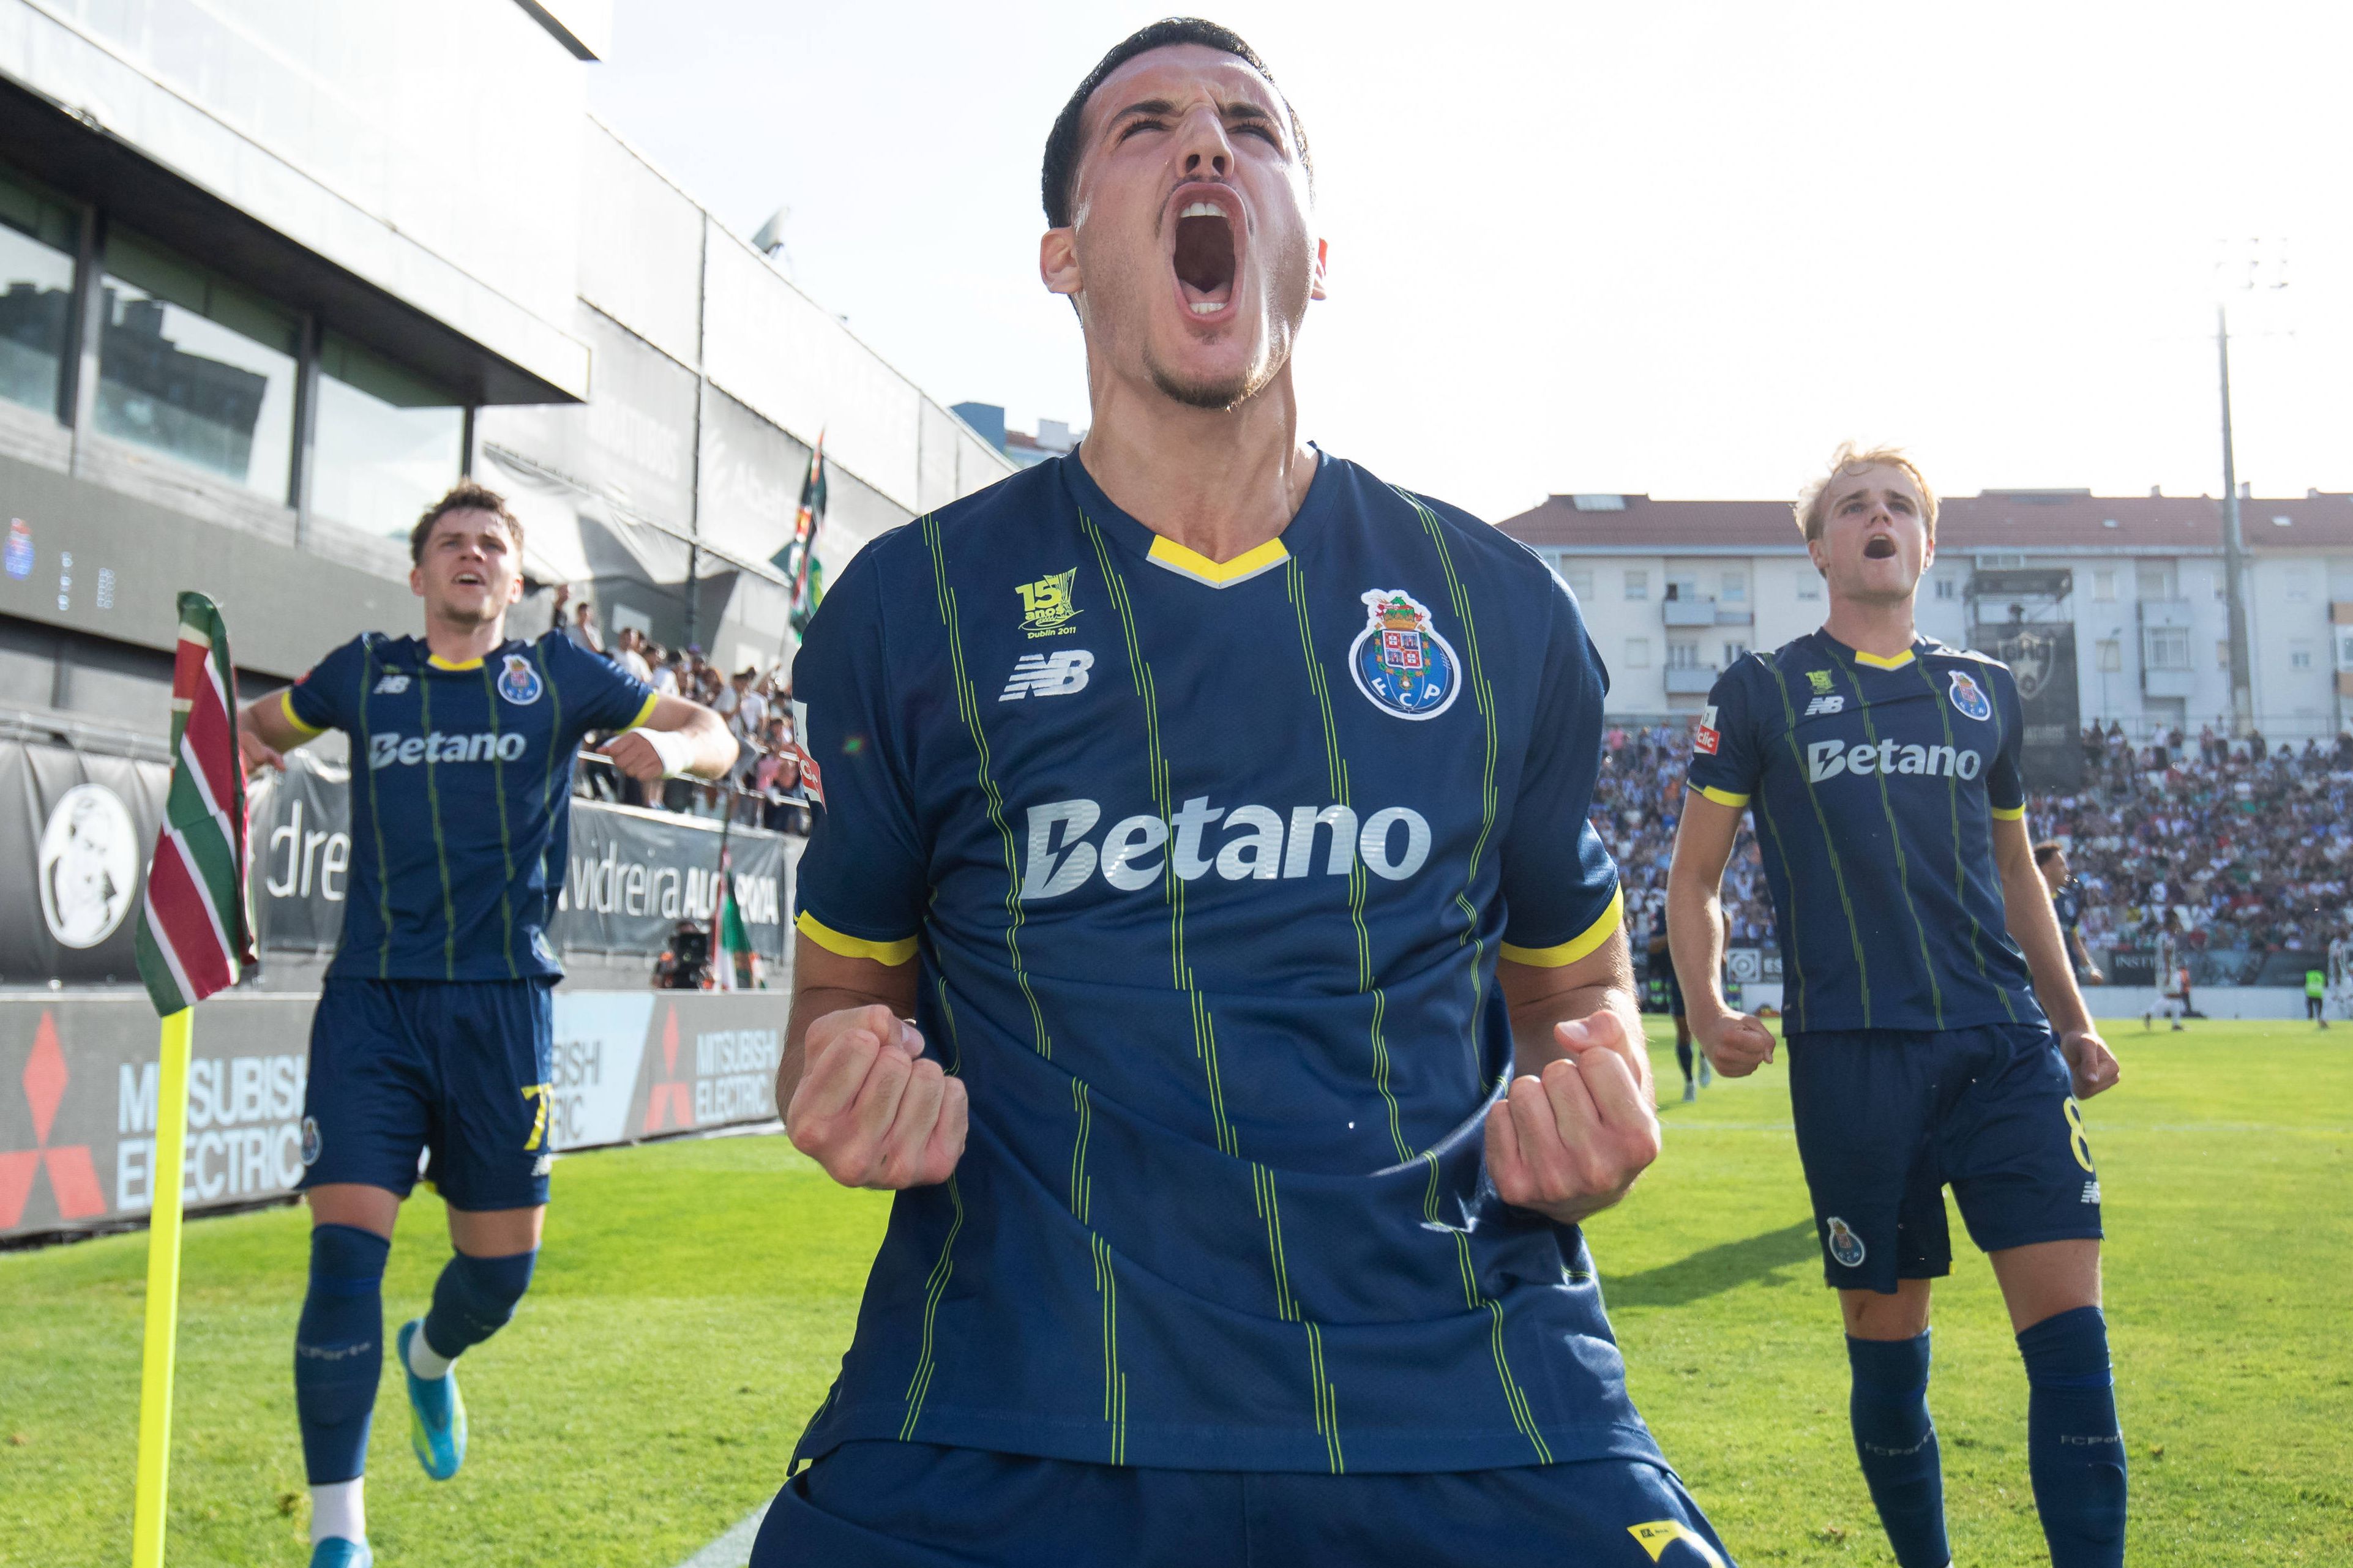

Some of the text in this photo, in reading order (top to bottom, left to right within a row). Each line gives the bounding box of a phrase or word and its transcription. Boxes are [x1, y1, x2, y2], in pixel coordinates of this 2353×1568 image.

[1014, 577, 1063, 612] 15
[1027, 625, 1077, 640] Dublin 2011
[998, 649, 1095, 703] NB
[1804, 695, 1844, 716] NB
[368, 731, 527, 771] Betano
[1807, 737, 1981, 784] Betano
[1018, 796, 1432, 900] Betano
[695, 1073, 770, 1124] ELECTRIC
[2063, 1096, 2094, 1173] 8
